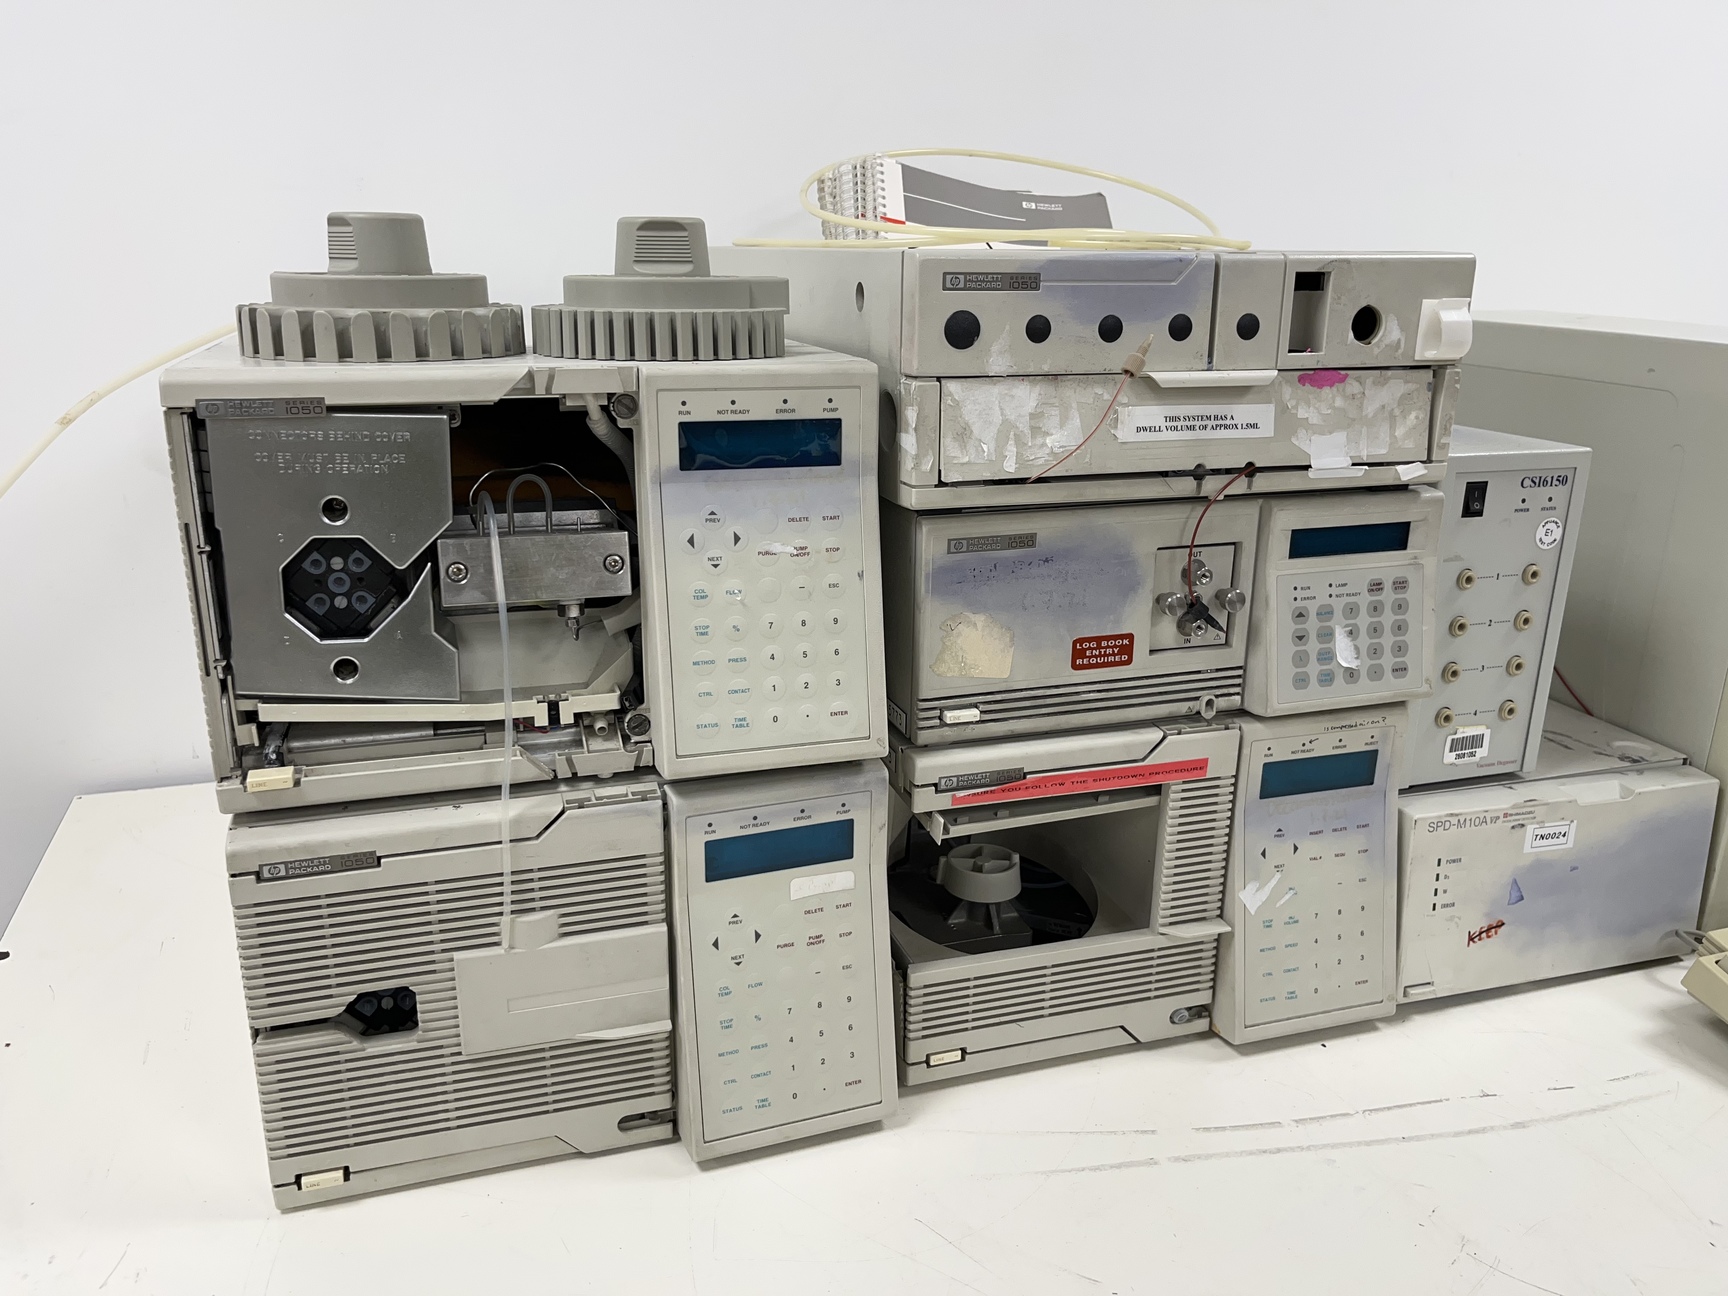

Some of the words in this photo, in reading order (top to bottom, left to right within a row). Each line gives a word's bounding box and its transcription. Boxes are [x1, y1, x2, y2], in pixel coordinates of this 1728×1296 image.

[286, 406, 323, 415] 1050
[248, 430, 324, 441] CONNECTORS
[329, 431, 370, 441] BEHIND
[375, 432, 411, 442] COVER
[254, 452, 291, 462] COVER
[335, 454, 349, 463] BE
[371, 453, 406, 464] PLACE
[326, 464, 388, 474] OPERATION
[1521, 475, 1568, 488] CSI6150
[1008, 540, 1034, 548] 1050
[1086, 648, 1120, 656] ENTRY
[1076, 655, 1128, 665] REQUIRED
[1092, 773, 1145, 783] SHUTDOWN
[1149, 766, 1205, 776] PROCEDURE
[1428, 816, 1488, 833] SPD-M10A
[1534, 831, 1567, 841] TN0024
[288, 858, 330, 868] HEWLETT
[340, 857, 375, 868] 1050
[289, 864, 331, 874] PACKARD
[1467, 919, 1505, 947] KEEP
